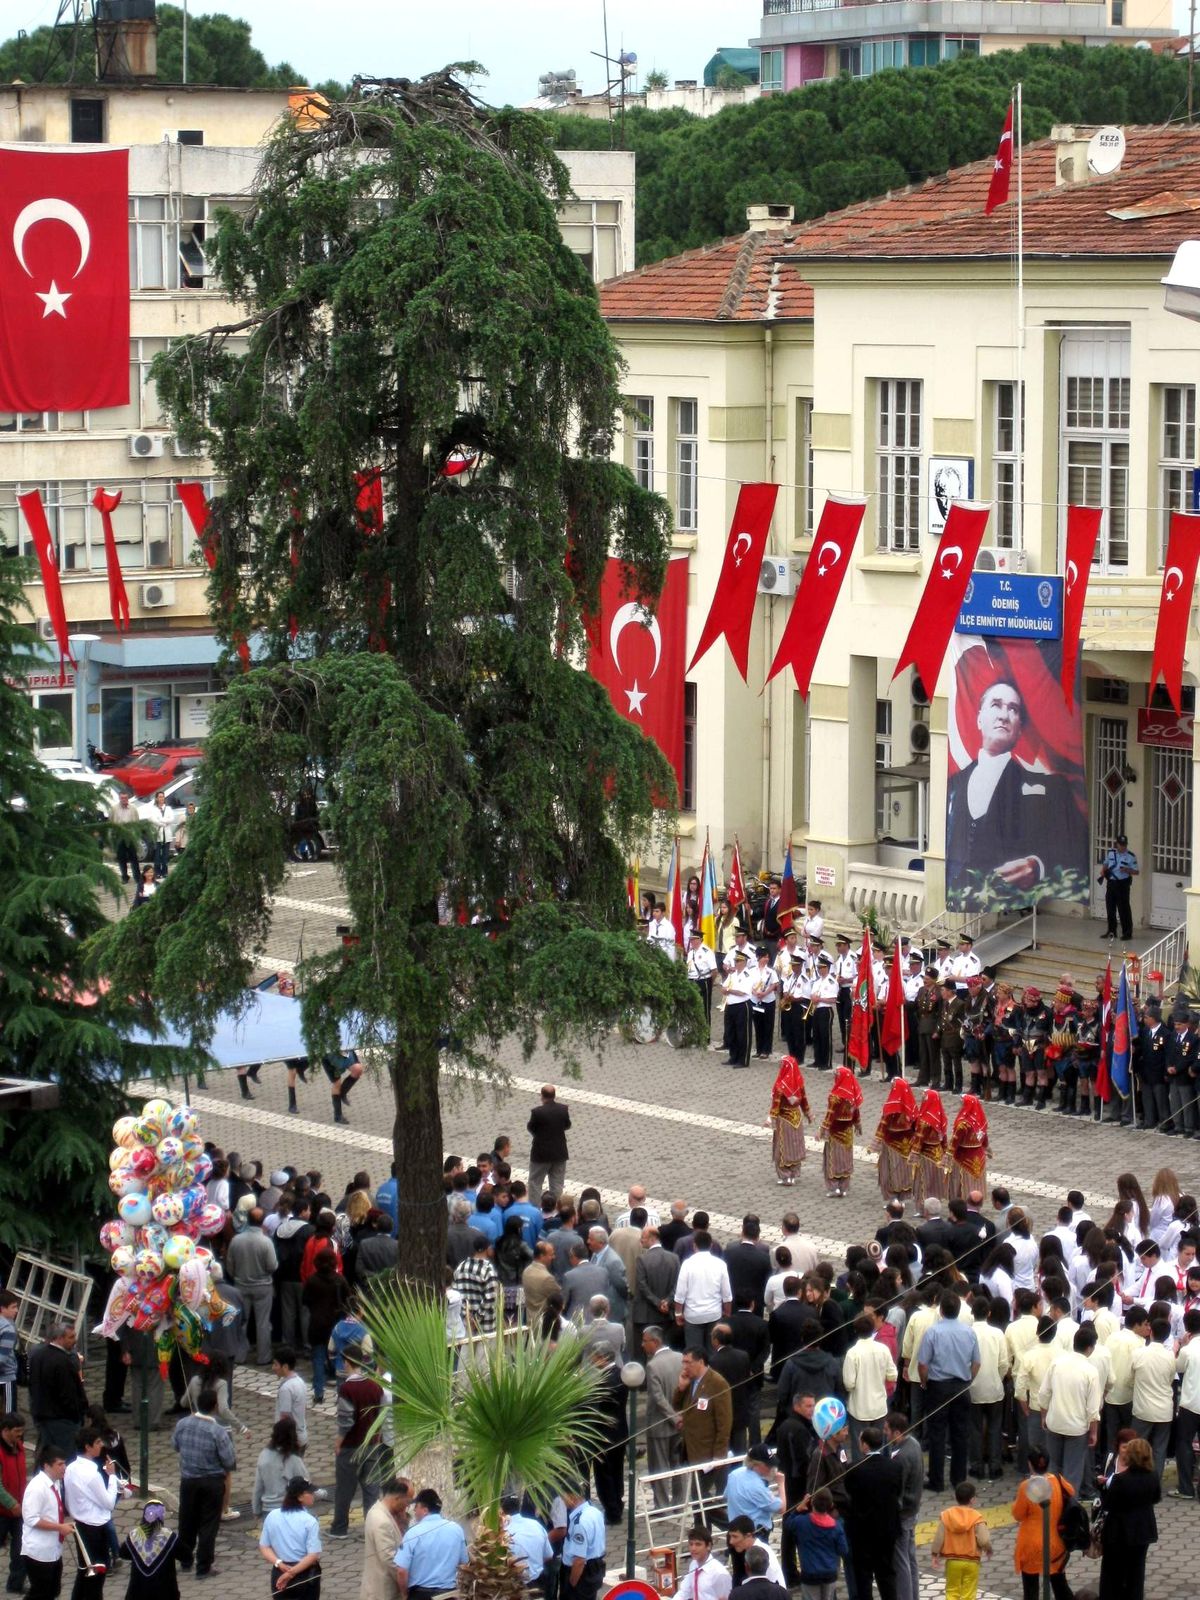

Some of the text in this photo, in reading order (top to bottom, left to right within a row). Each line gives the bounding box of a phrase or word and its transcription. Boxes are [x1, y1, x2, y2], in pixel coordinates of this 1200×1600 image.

[1000, 581, 1012, 591] T.C.
[992, 596, 1020, 612] ÖDEMİŞ
[960, 612, 1053, 631] İLÇE EMNİYET MÜDÜRLÜĞÜ
